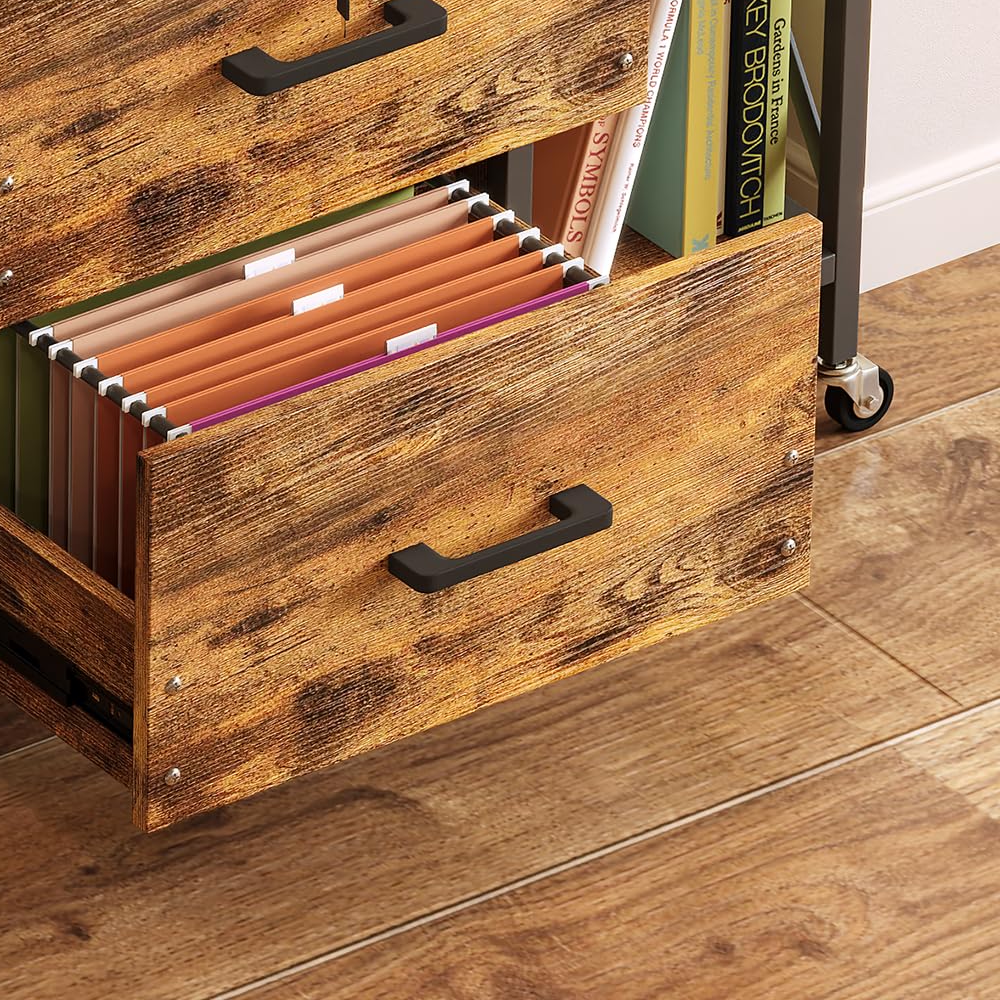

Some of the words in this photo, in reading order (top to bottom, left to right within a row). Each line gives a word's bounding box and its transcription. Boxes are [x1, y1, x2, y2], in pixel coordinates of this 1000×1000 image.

[649, 51, 666, 88] WORLD
[772, 17, 787, 79] Gardens
[772, 79, 784, 94] in
[632, 90, 655, 149] CHAMPIONS
[738, 49, 767, 220] BRODOVITCH
[769, 95, 784, 145] France
[565, 131, 611, 244] SYMBOLS
